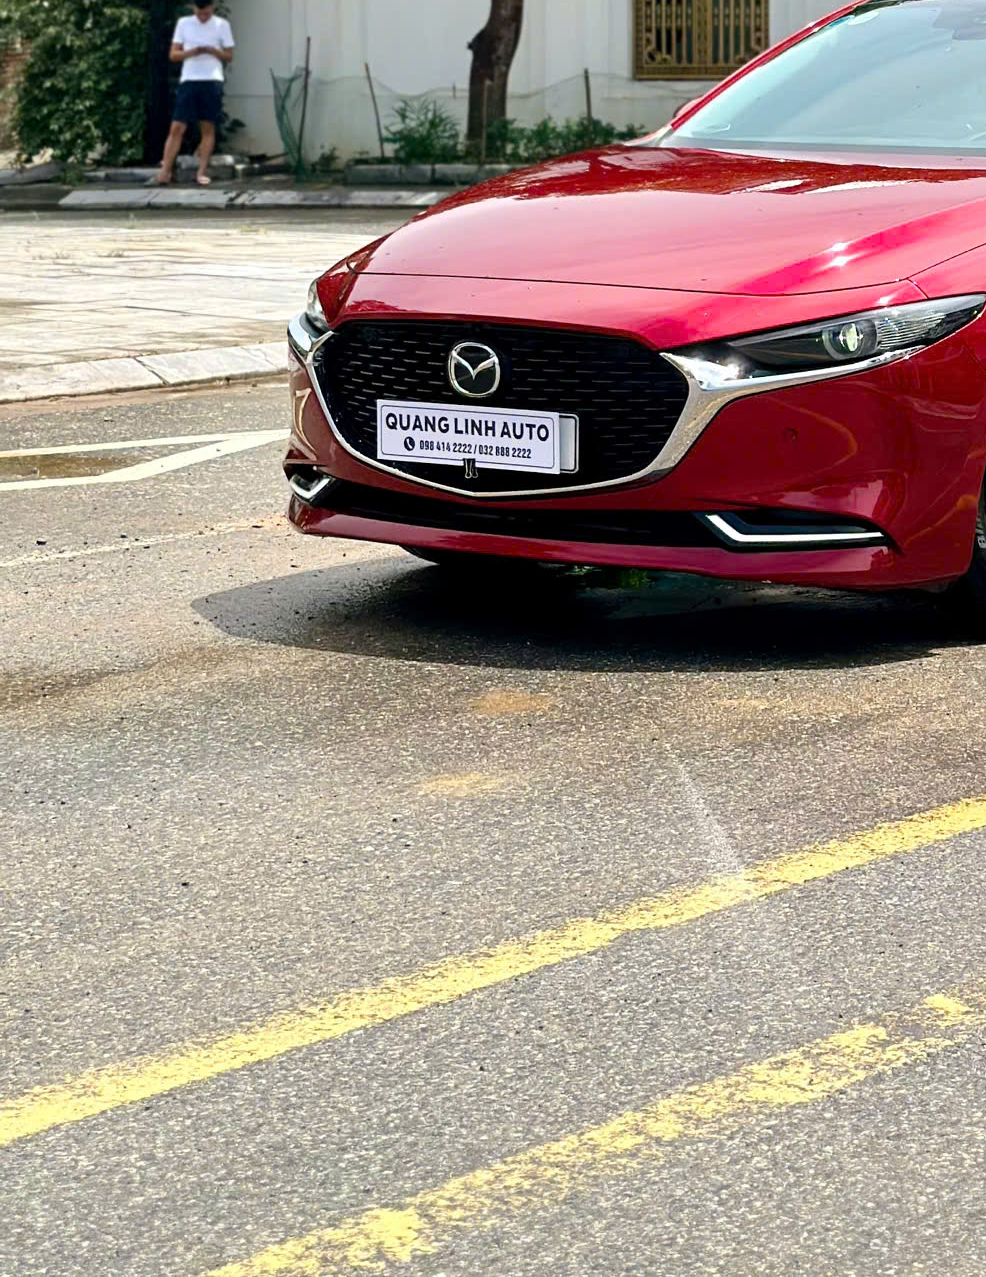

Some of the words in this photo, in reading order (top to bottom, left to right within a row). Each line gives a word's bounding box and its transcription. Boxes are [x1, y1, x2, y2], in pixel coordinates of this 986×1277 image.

[385, 412, 450, 434] QUANG
[454, 417, 496, 437] LINH
[500, 421, 550, 442] AUTO
[419, 439, 435, 451] 098
[436, 441, 451, 452] 414
[452, 442, 473, 454] 2222
[478, 444, 494, 456] 032
[495, 445, 510, 457] 888
[511, 447, 532, 459] 2222
